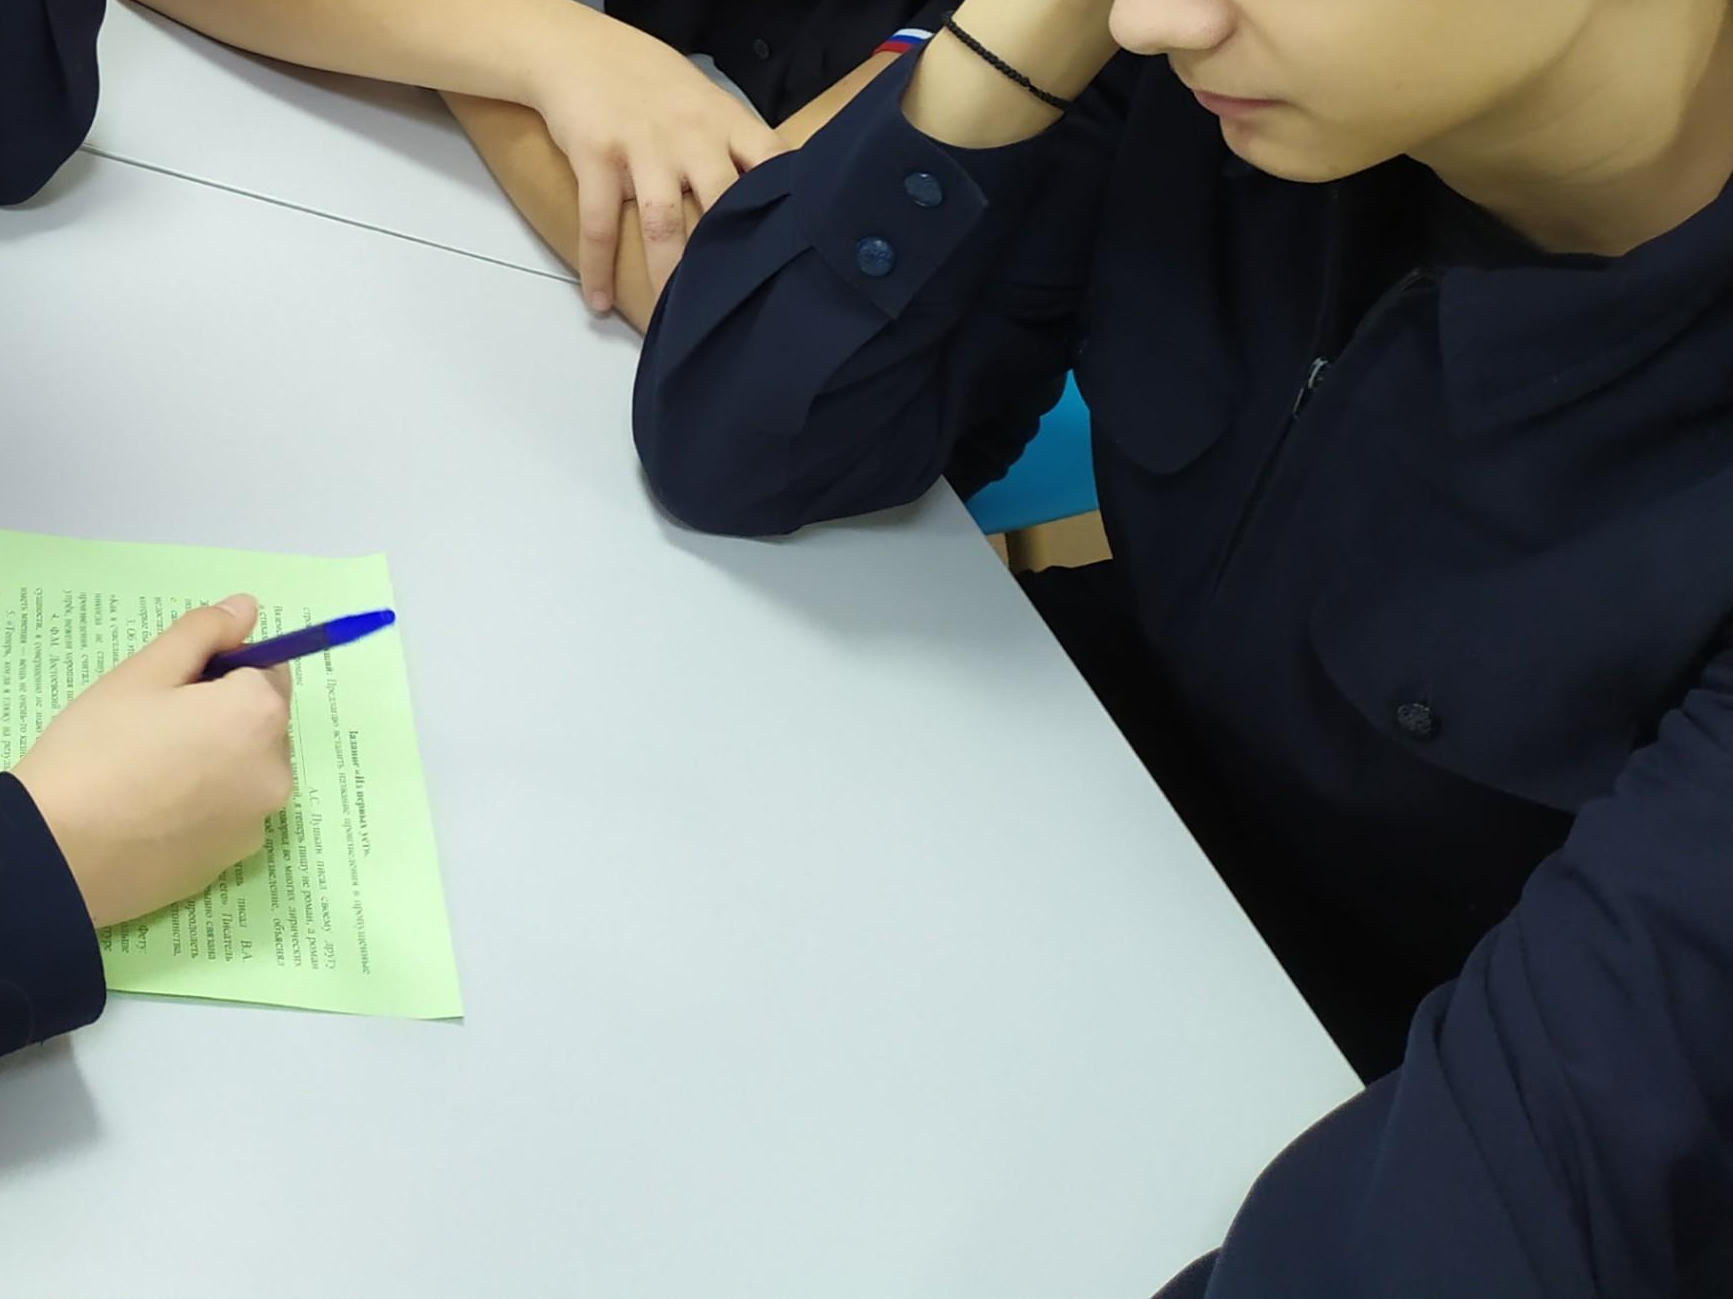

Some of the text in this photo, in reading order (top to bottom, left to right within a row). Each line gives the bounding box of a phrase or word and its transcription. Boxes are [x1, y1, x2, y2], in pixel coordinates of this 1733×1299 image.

[19, 587, 27, 610] иметь
[94, 593, 102, 625] никогда
[139, 596, 149, 642] которые бы
[63, 618, 72, 649] нежели
[126, 628, 134, 640] Об
[3, 661, 11, 686] когда
[33, 641, 41, 694] совершенно
[49, 653, 59, 709] Достоевский
[64, 651, 74, 688] хорошая
[2, 697, 10, 723] гляжу
[3, 726, 10, 737] на
[332, 729, 346, 770] вставить
[337, 771, 351, 815] название
[354, 790, 368, 829] первых
[342, 817, 360, 887] произведения
[293, 810, 321, 970] теперь пишу роман, роман
[307, 785, 337, 970] А.С. Пушкин писал своему другу
[263, 837, 287, 967] произведение, объяснял
[281, 849, 304, 967] во многих лирических
[204, 920, 216, 960] связана
[220, 912, 235, 962] Писатель
[236, 898, 252, 963] писал В.А.
[352, 899, 370, 973] пропущенные
